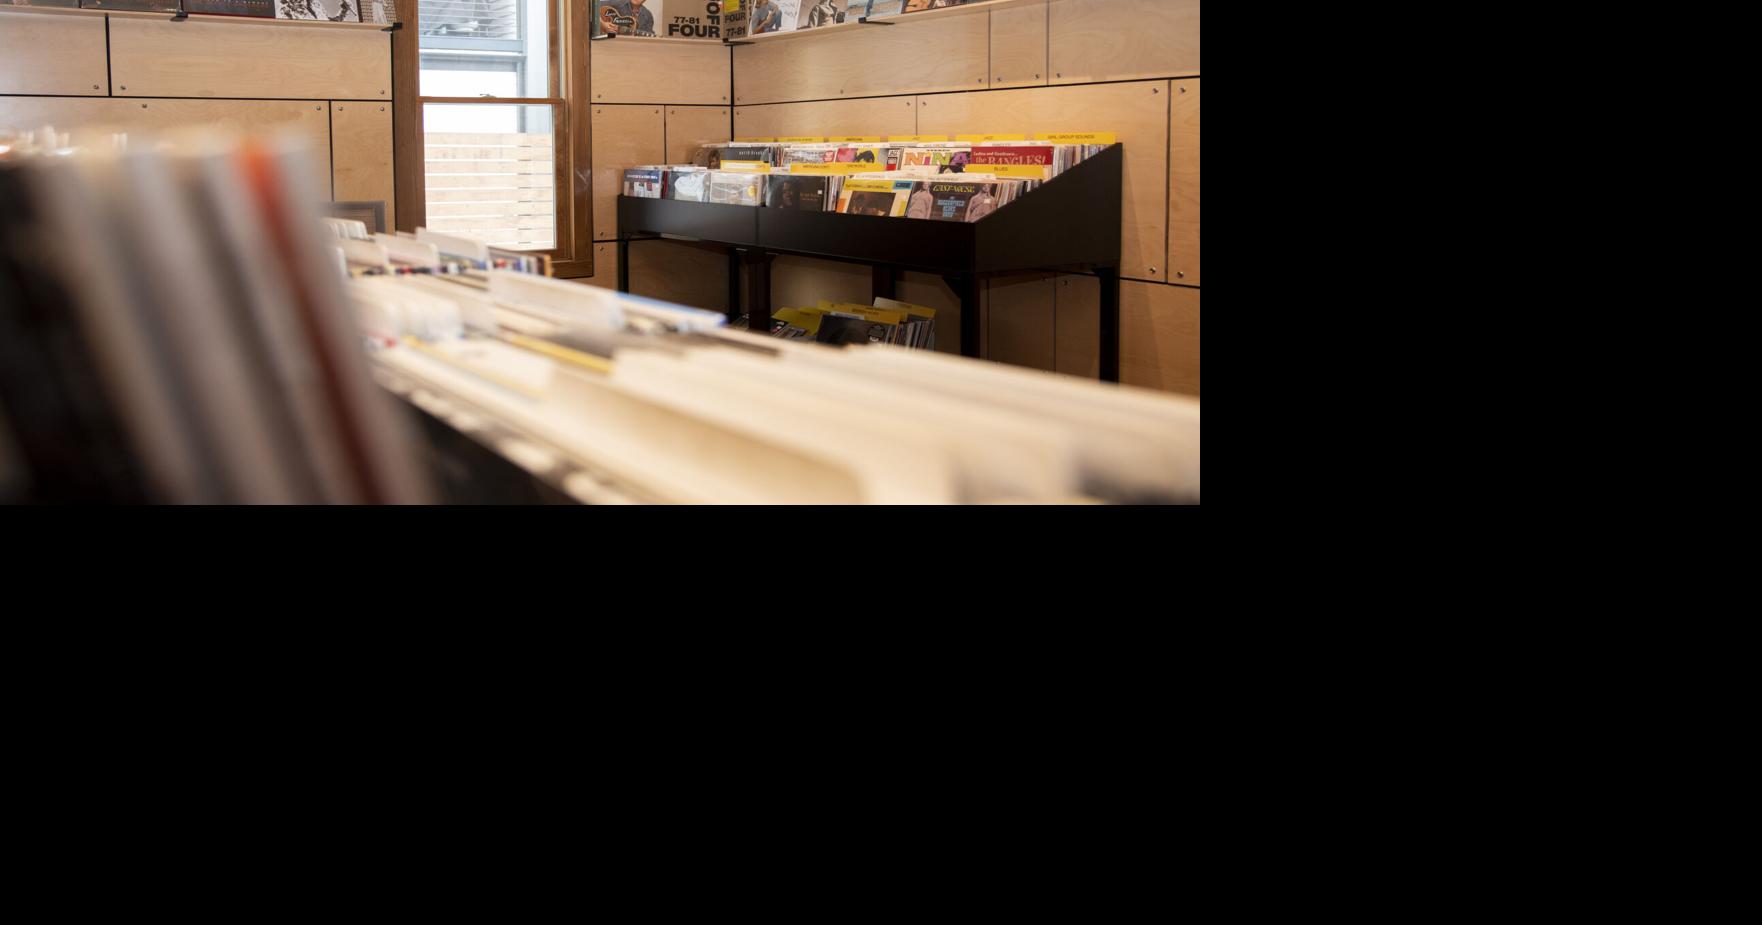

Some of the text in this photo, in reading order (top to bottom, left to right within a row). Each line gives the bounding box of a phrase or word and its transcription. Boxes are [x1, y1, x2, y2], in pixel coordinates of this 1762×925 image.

[673, 16, 700, 24] 77-81
[725, 12, 746, 24] FOUR
[668, 23, 720, 38] FOUR
[726, 26, 746, 37] 77-81
[988, 154, 1046, 165] BANGLES!
